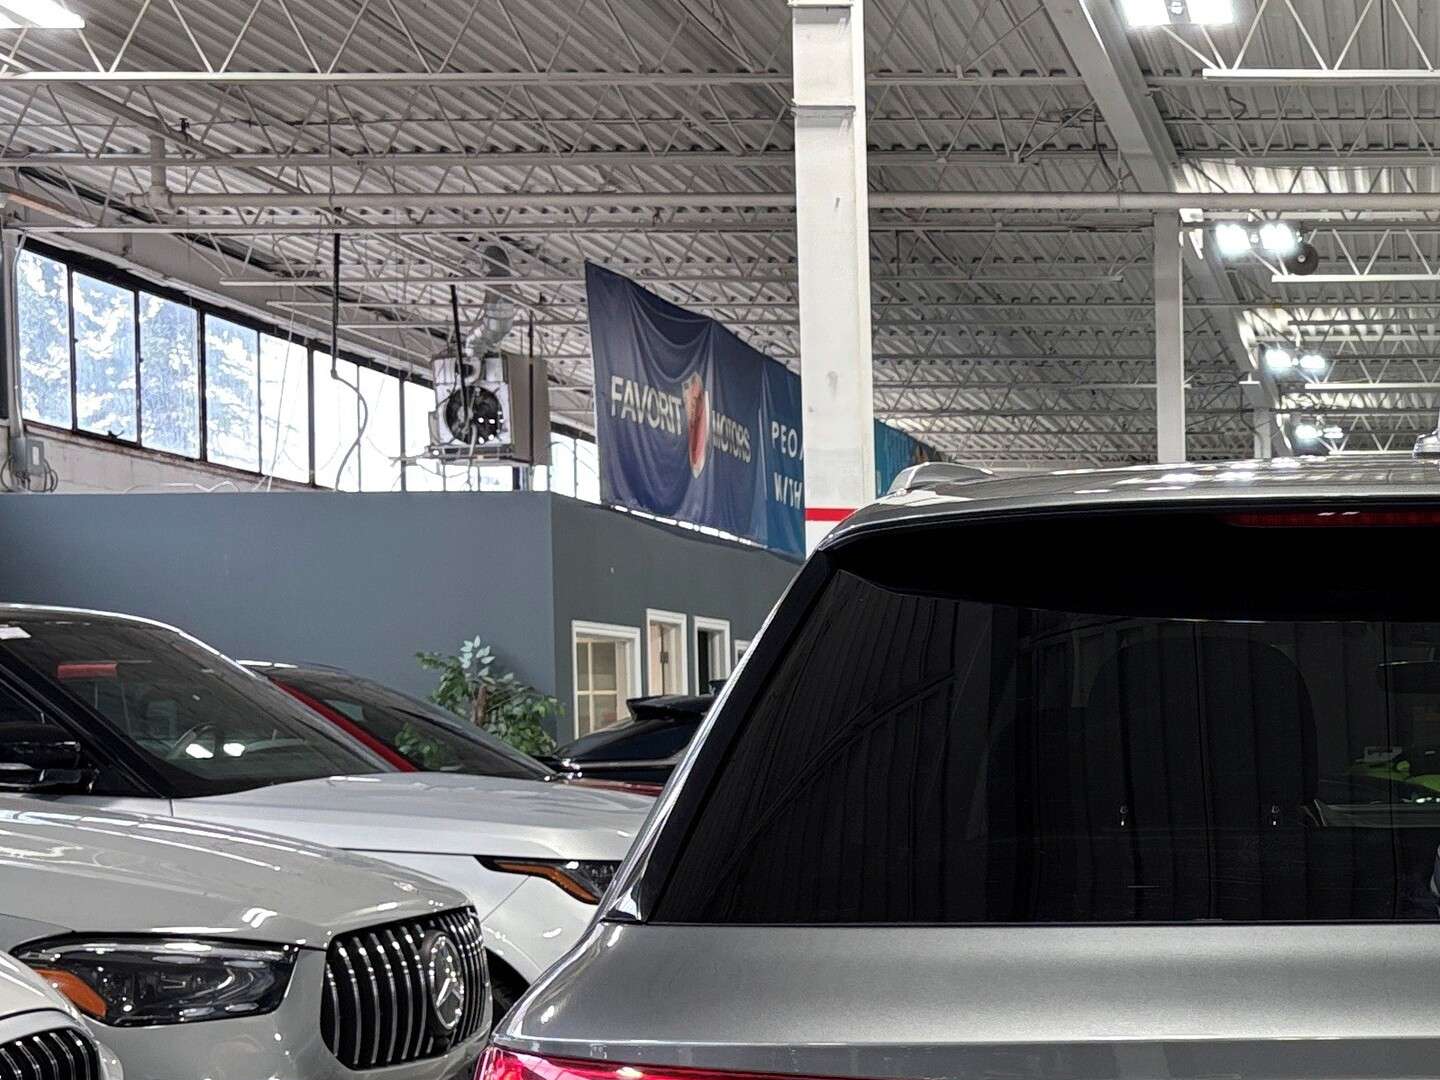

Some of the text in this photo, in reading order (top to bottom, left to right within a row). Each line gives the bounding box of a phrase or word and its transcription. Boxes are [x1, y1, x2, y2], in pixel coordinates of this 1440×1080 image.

[611, 375, 751, 463] FAVORIT MOTORS
[772, 420, 803, 460] PEO
